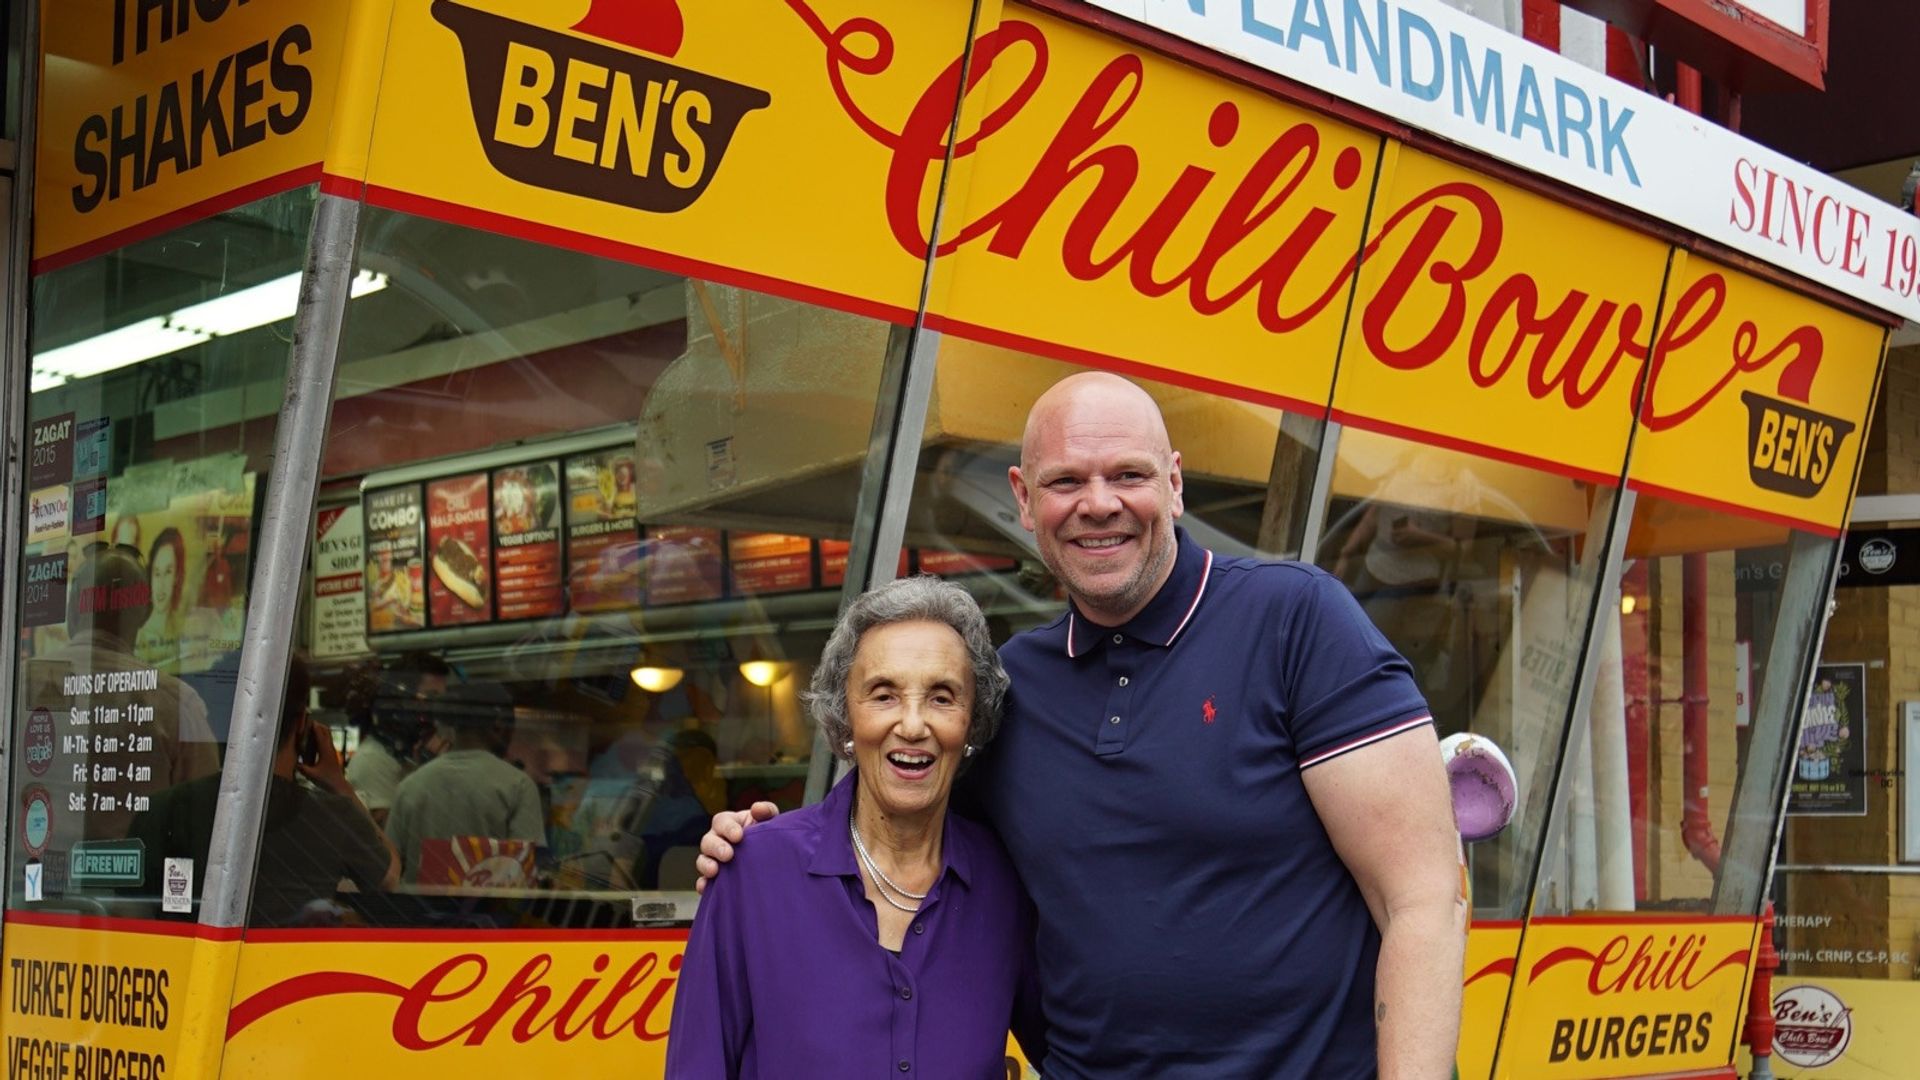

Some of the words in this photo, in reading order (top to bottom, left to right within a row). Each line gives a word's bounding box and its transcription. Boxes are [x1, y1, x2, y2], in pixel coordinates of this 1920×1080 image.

[1242, 0, 1642, 188] LANDMARK
[72, 24, 313, 214] SHAKES
[494, 41, 712, 189] BEN'S
[885, 20, 1368, 334] Chili
[1362, 183, 1730, 432] Bowl
[1729, 158, 1871, 278] SINCE
[1881, 228, 1920, 304] 19
[34, 420, 71, 446] ZAGAT
[33, 445, 56, 467] 2015
[1754, 408, 1834, 485] BEN'S
[369, 505, 418, 531] COMBO
[499, 533, 523, 547] VEGGIE
[27, 559, 65, 583] ZAGAT
[26, 584, 49, 604] 2014
[64, 676, 92, 696] HOURS
[94, 675, 106, 693] OF
[107, 670, 157, 692] OPERATION
[70, 706, 90, 726] Sun:
[94, 706, 119, 724] 11am
[127, 704, 154, 726] 11pm
[63, 736, 89, 754] M-Th:
[94, 735, 101, 753] 6
[103, 738, 118, 753] am
[128, 734, 135, 752] 2
[136, 736, 153, 752] am
[73, 764, 88, 782] Fri:
[93, 764, 100, 782] 6
[102, 766, 117, 782] am
[126, 763, 134, 782] 4
[135, 766, 151, 782] am
[69, 792, 86, 811] Sat:
[92, 793, 98, 811] 7
[100, 795, 115, 811] am
[125, 793, 132, 811] 4
[134, 795, 149, 811] am
[86, 856, 112, 873] FREE
[113, 856, 137, 873] WIFI
[1773, 916, 1832, 928] THERAPY
[1588, 933, 1708, 996] Chili
[1816, 950, 1854, 963] CRNP,
[1856, 951, 1889, 964] CS-P,
[11, 958, 77, 1019] TURKEY
[81, 963, 169, 1031] BURGERS
[392, 952, 685, 1051] Chili
[1774, 999, 1833, 1023] Ben's
[1549, 1011, 1713, 1064] BURGERS
[8, 1036, 70, 1080] VEGGIE
